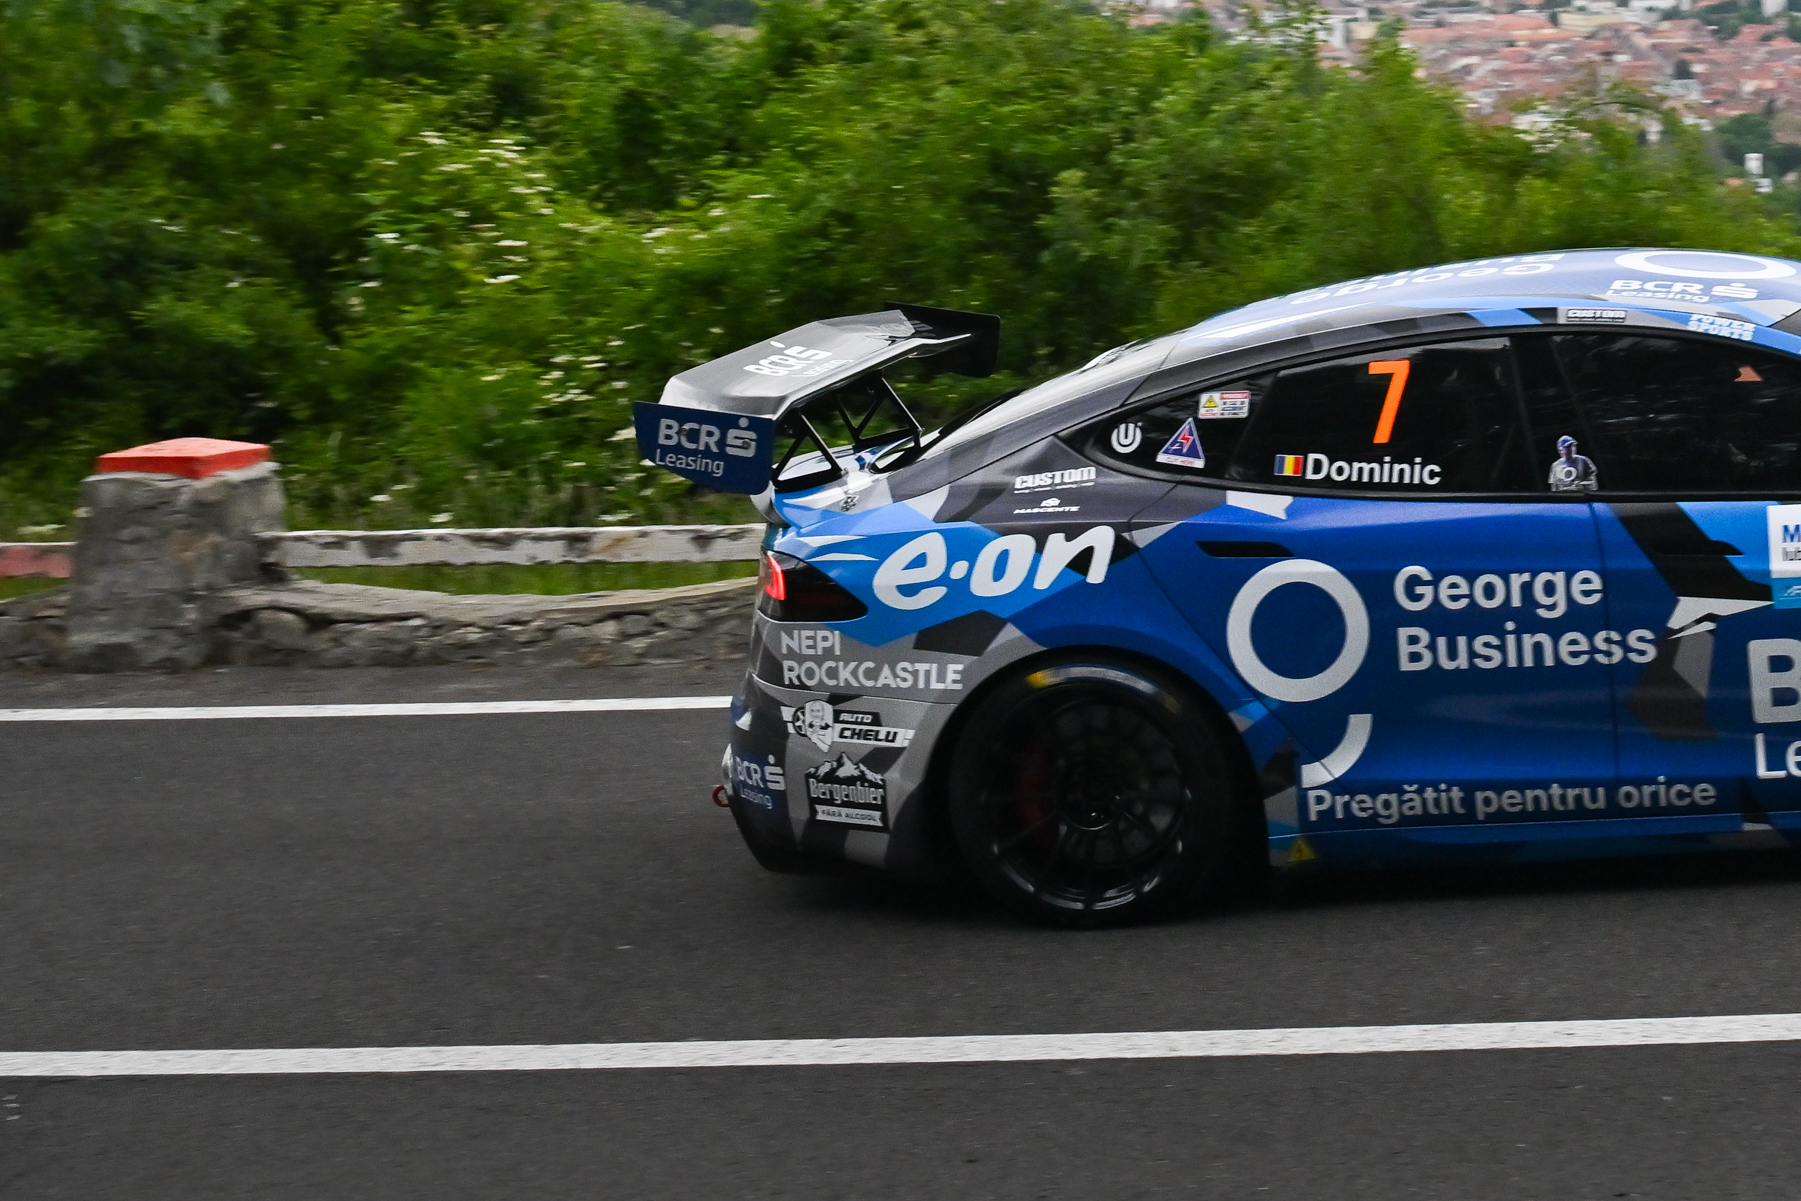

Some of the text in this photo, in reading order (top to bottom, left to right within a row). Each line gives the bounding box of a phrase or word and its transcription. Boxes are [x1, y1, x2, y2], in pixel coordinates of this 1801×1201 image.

[1604, 289, 1710, 303] Leasing
[1611, 279, 1705, 295] BCR
[1687, 321, 1754, 341] SPORTS
[1689, 313, 1757, 332] POWER
[1368, 360, 1410, 444] 7
[657, 417, 720, 453] BCR
[654, 448, 725, 478] Leasing
[1305, 452, 1442, 486] Dominic
[1014, 466, 1097, 489] CUSTOM
[1393, 565, 1604, 619] George
[780, 630, 841, 656] NEPI
[1397, 621, 1658, 672] Business
[782, 660, 965, 690] ROCKCASTLE
[839, 712, 873, 723] AUTO
[838, 729, 898, 744] CHELU
[808, 777, 885, 805] Bergenbier
[1307, 776, 1718, 824] Pregătit pentru orice
